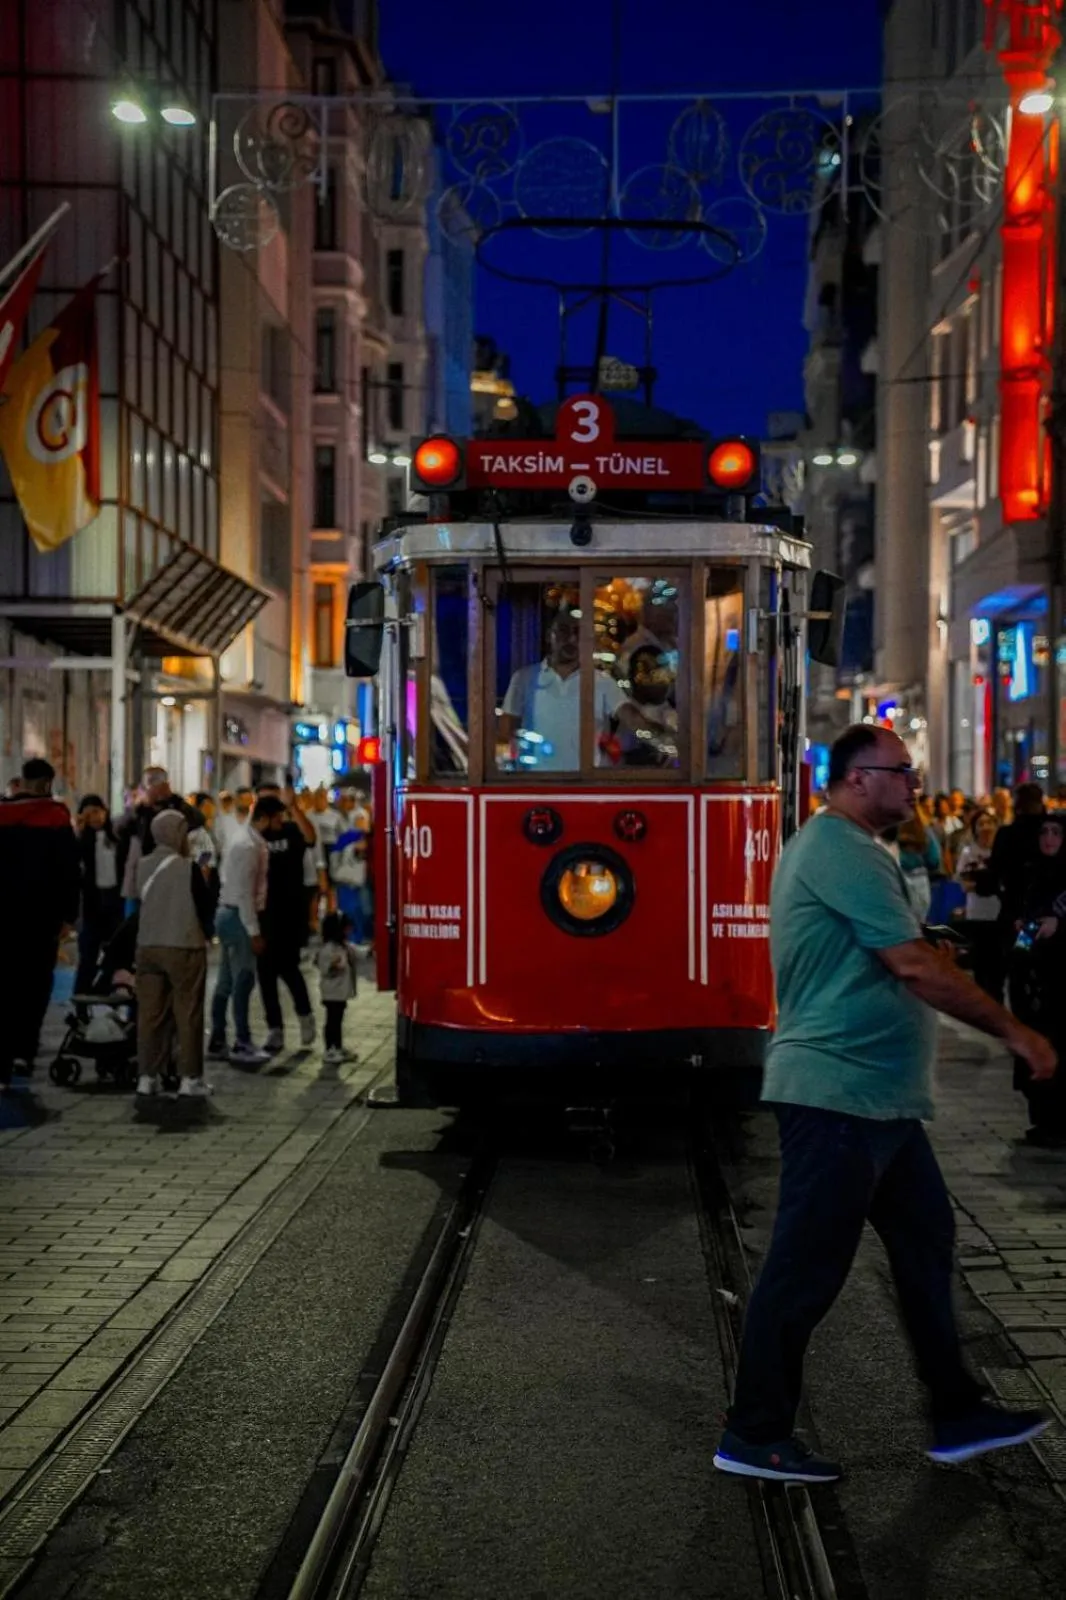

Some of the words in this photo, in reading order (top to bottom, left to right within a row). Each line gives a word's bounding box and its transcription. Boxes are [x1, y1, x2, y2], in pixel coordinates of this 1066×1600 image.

[570, 400, 600, 443] 3
[480, 452, 564, 473] TAKSİM
[595, 453, 670, 475] TÜNEL
[712, 923, 725, 939] VE
